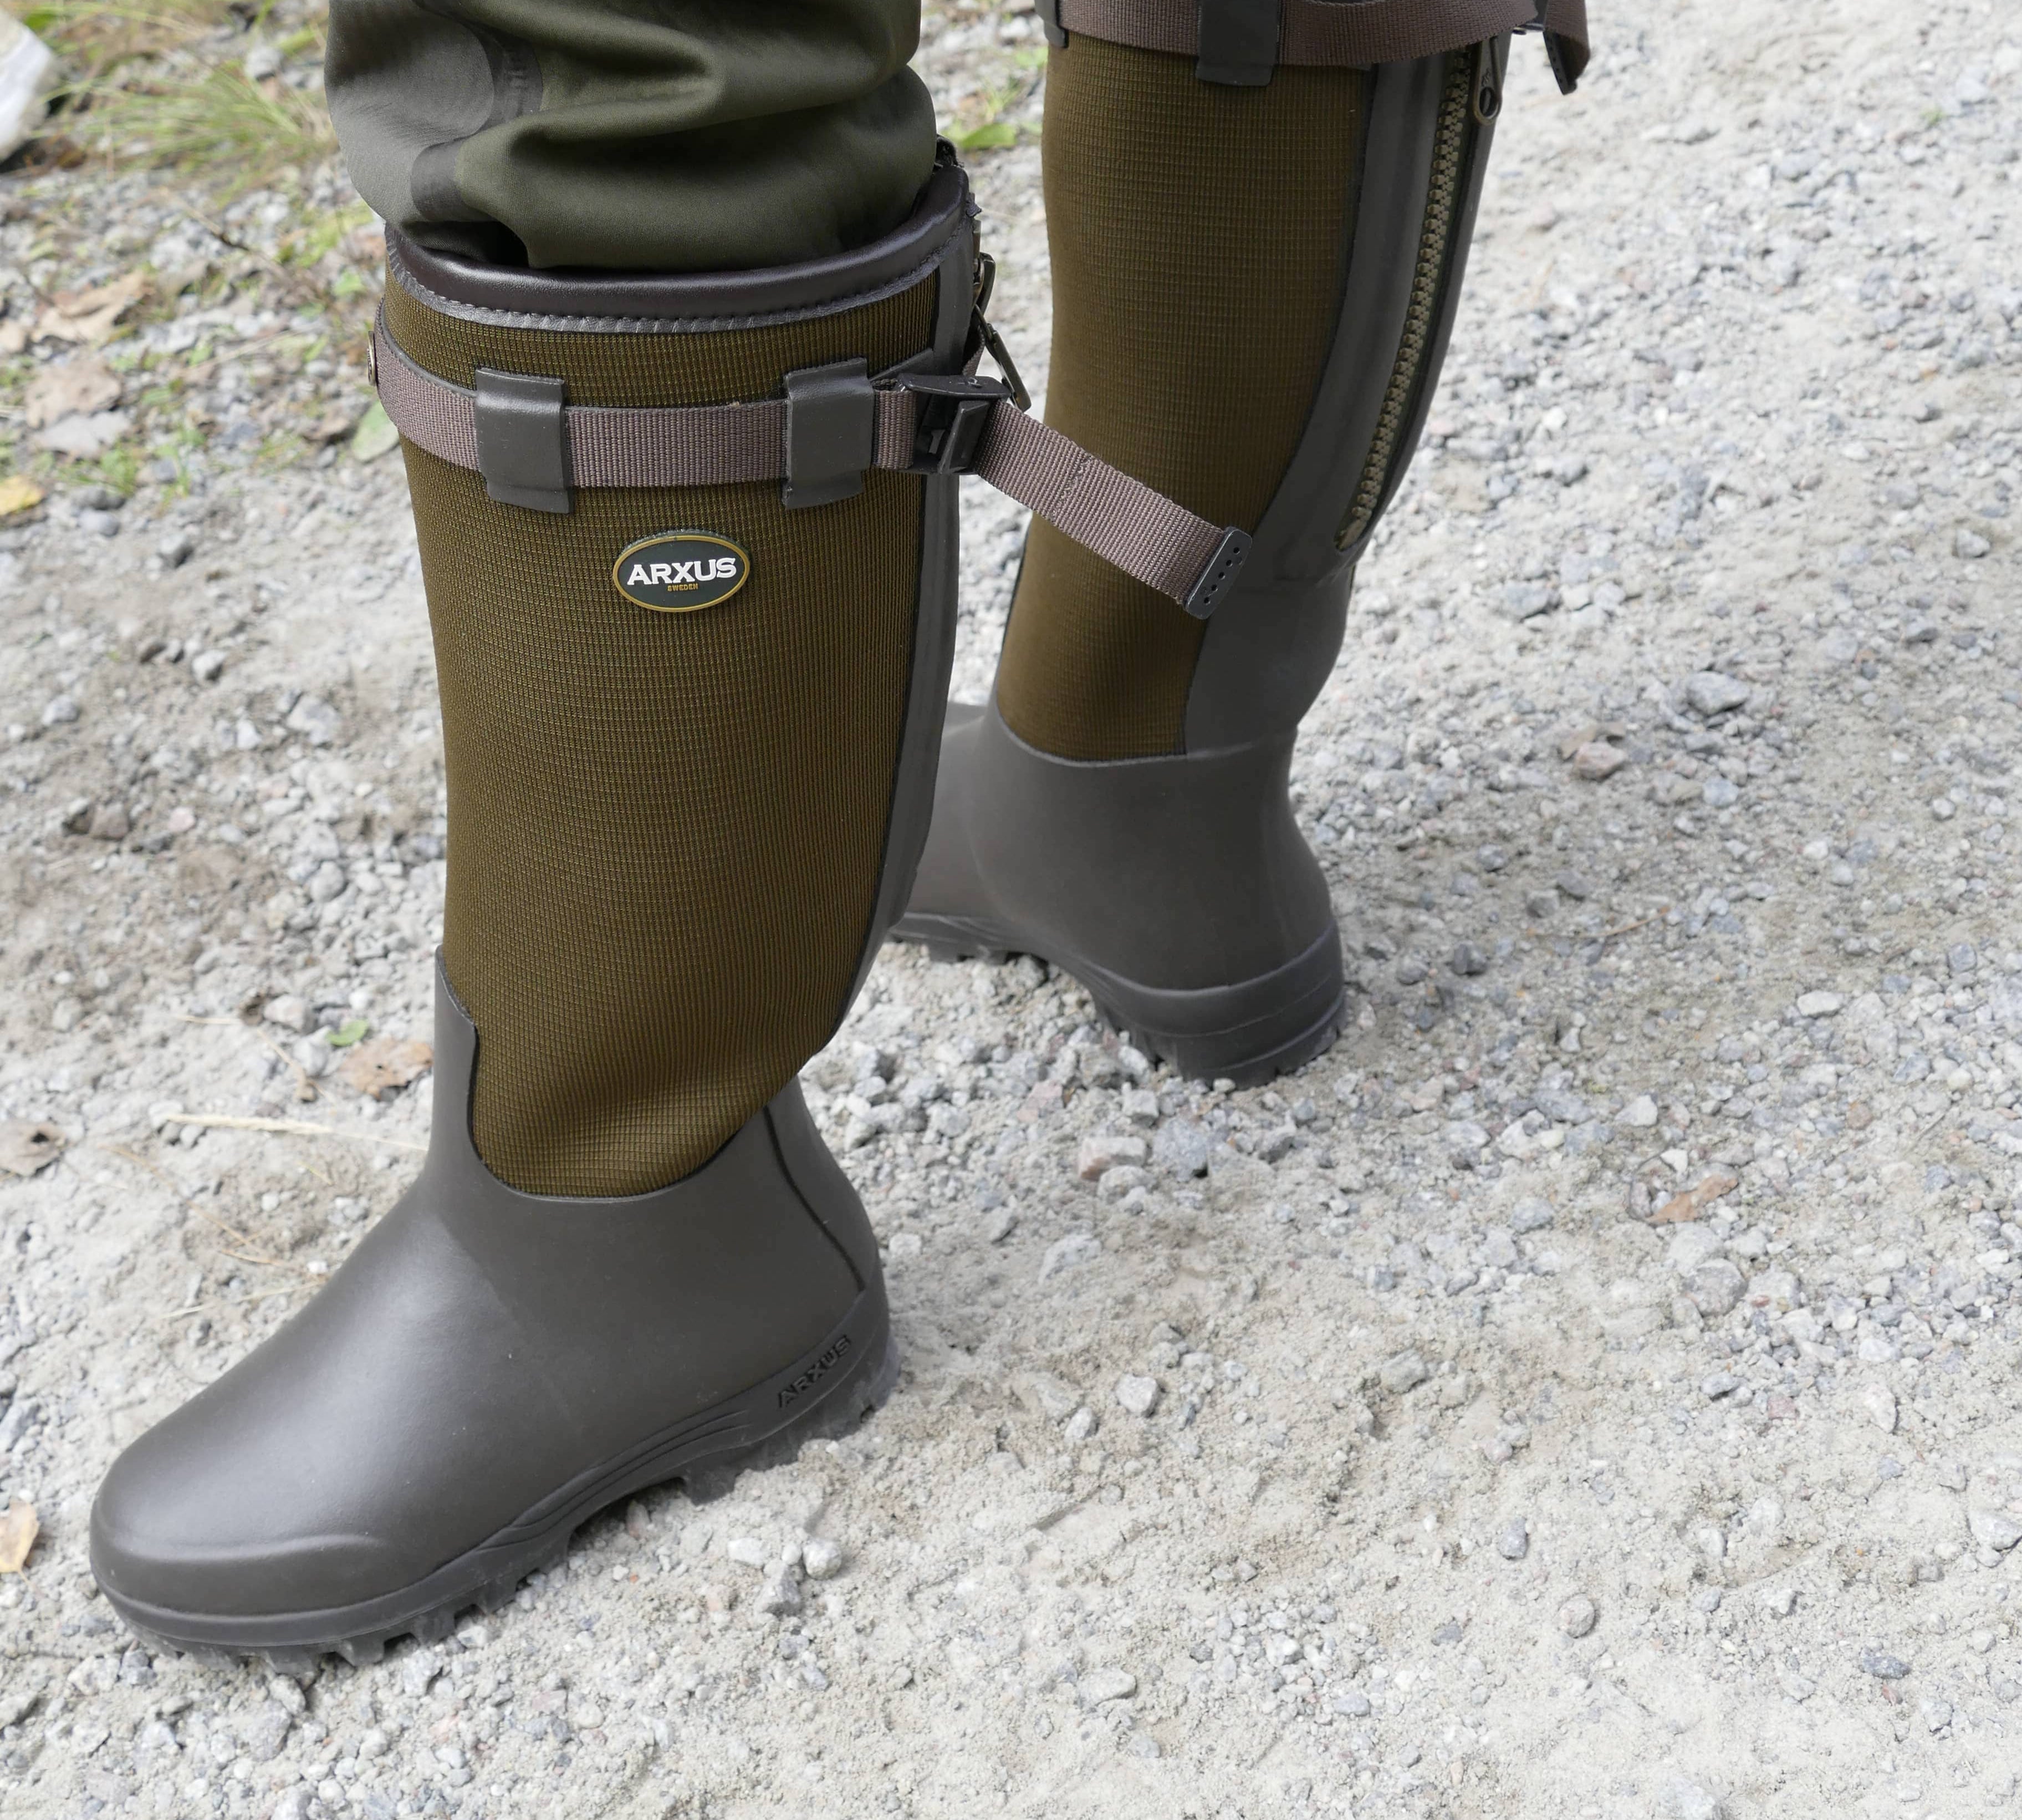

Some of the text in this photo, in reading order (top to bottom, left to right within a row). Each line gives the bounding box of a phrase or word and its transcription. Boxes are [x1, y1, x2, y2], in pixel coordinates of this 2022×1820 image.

[627, 557, 737, 585] ARXUS
[667, 583, 698, 592] SWEDEN
[778, 1334, 851, 1408] ARXUS
